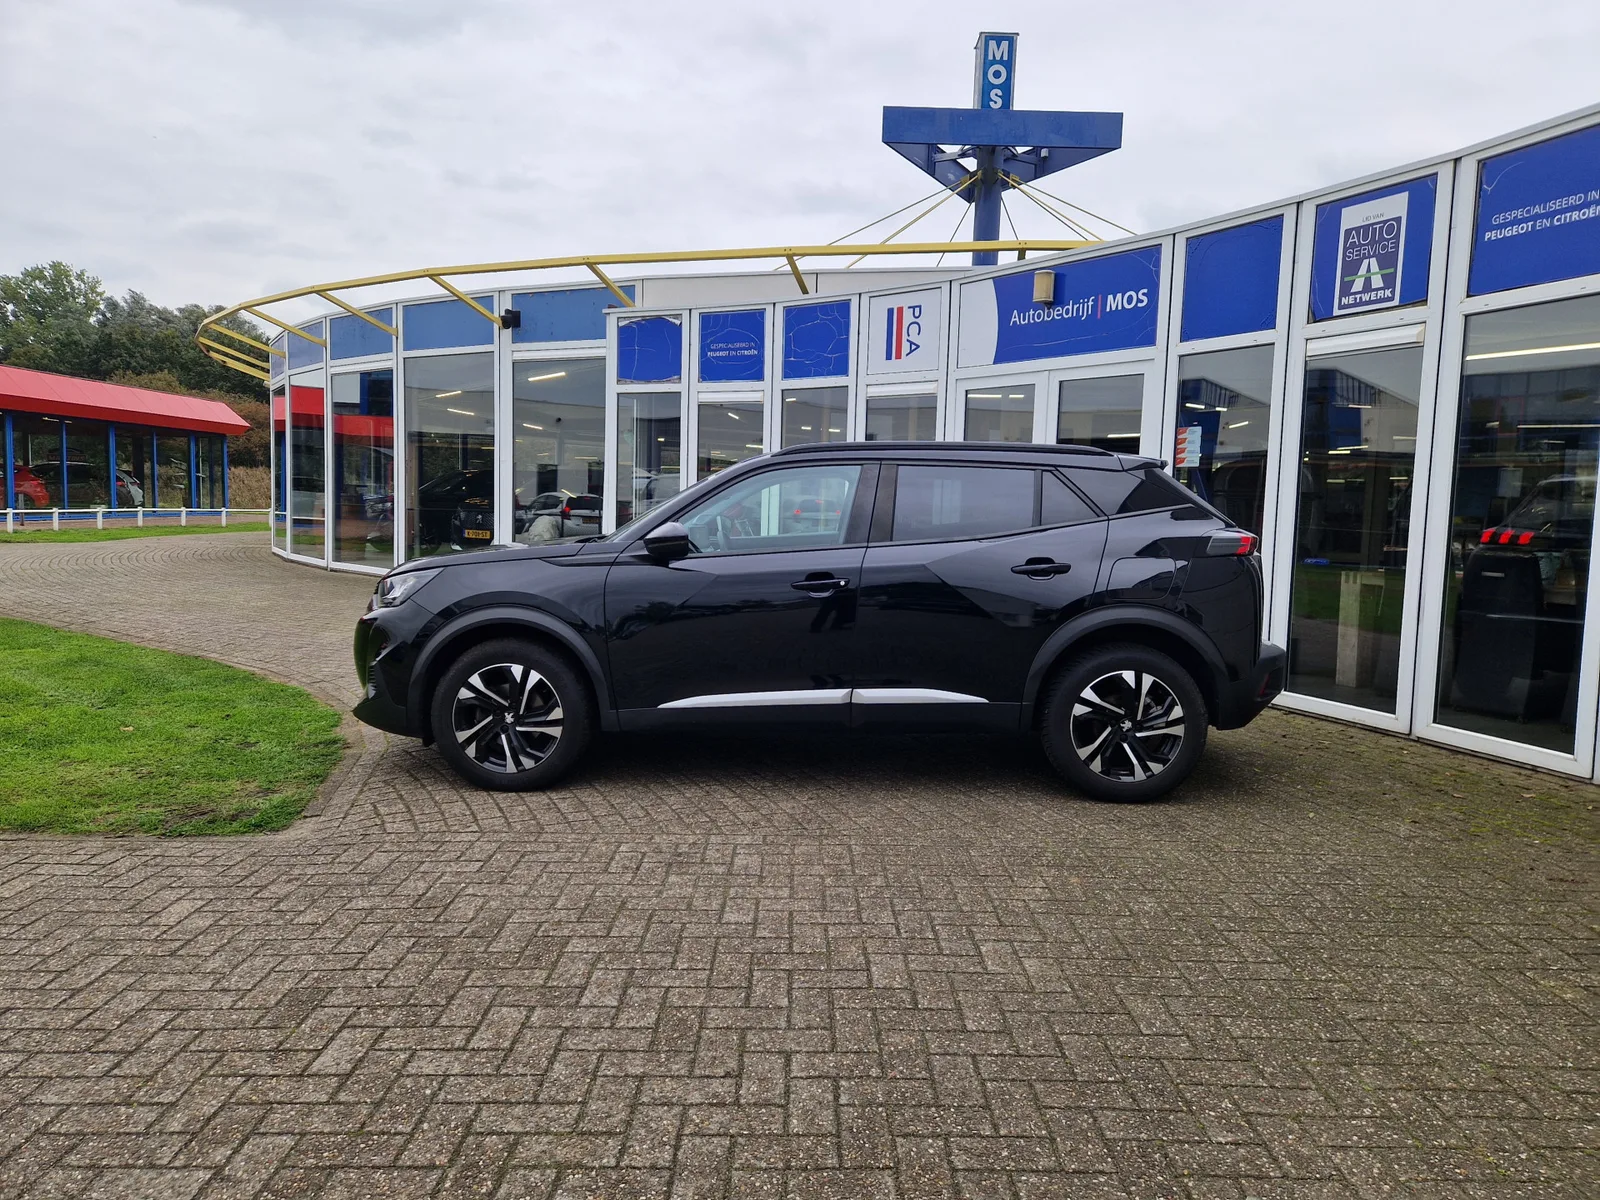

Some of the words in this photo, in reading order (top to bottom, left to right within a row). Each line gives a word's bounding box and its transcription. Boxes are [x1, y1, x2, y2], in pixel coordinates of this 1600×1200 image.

[987, 40, 1009, 109] MOS
[1372, 212, 1385, 220] VAN
[1492, 194, 1584, 225] GESPECIALISEERD
[1588, 189, 1600, 201] IN
[1346, 220, 1397, 248] AUTO
[1485, 222, 1533, 241] PEUGEOT
[1536, 218, 1551, 230] EN
[1345, 239, 1397, 261] SERVICE
[1009, 296, 1095, 326] Autobedrijf
[1106, 288, 1148, 312] MOS
[1341, 288, 1393, 306] NETWERK
[905, 305, 922, 357] PCA
[736, 348, 759, 356] CITROËN
